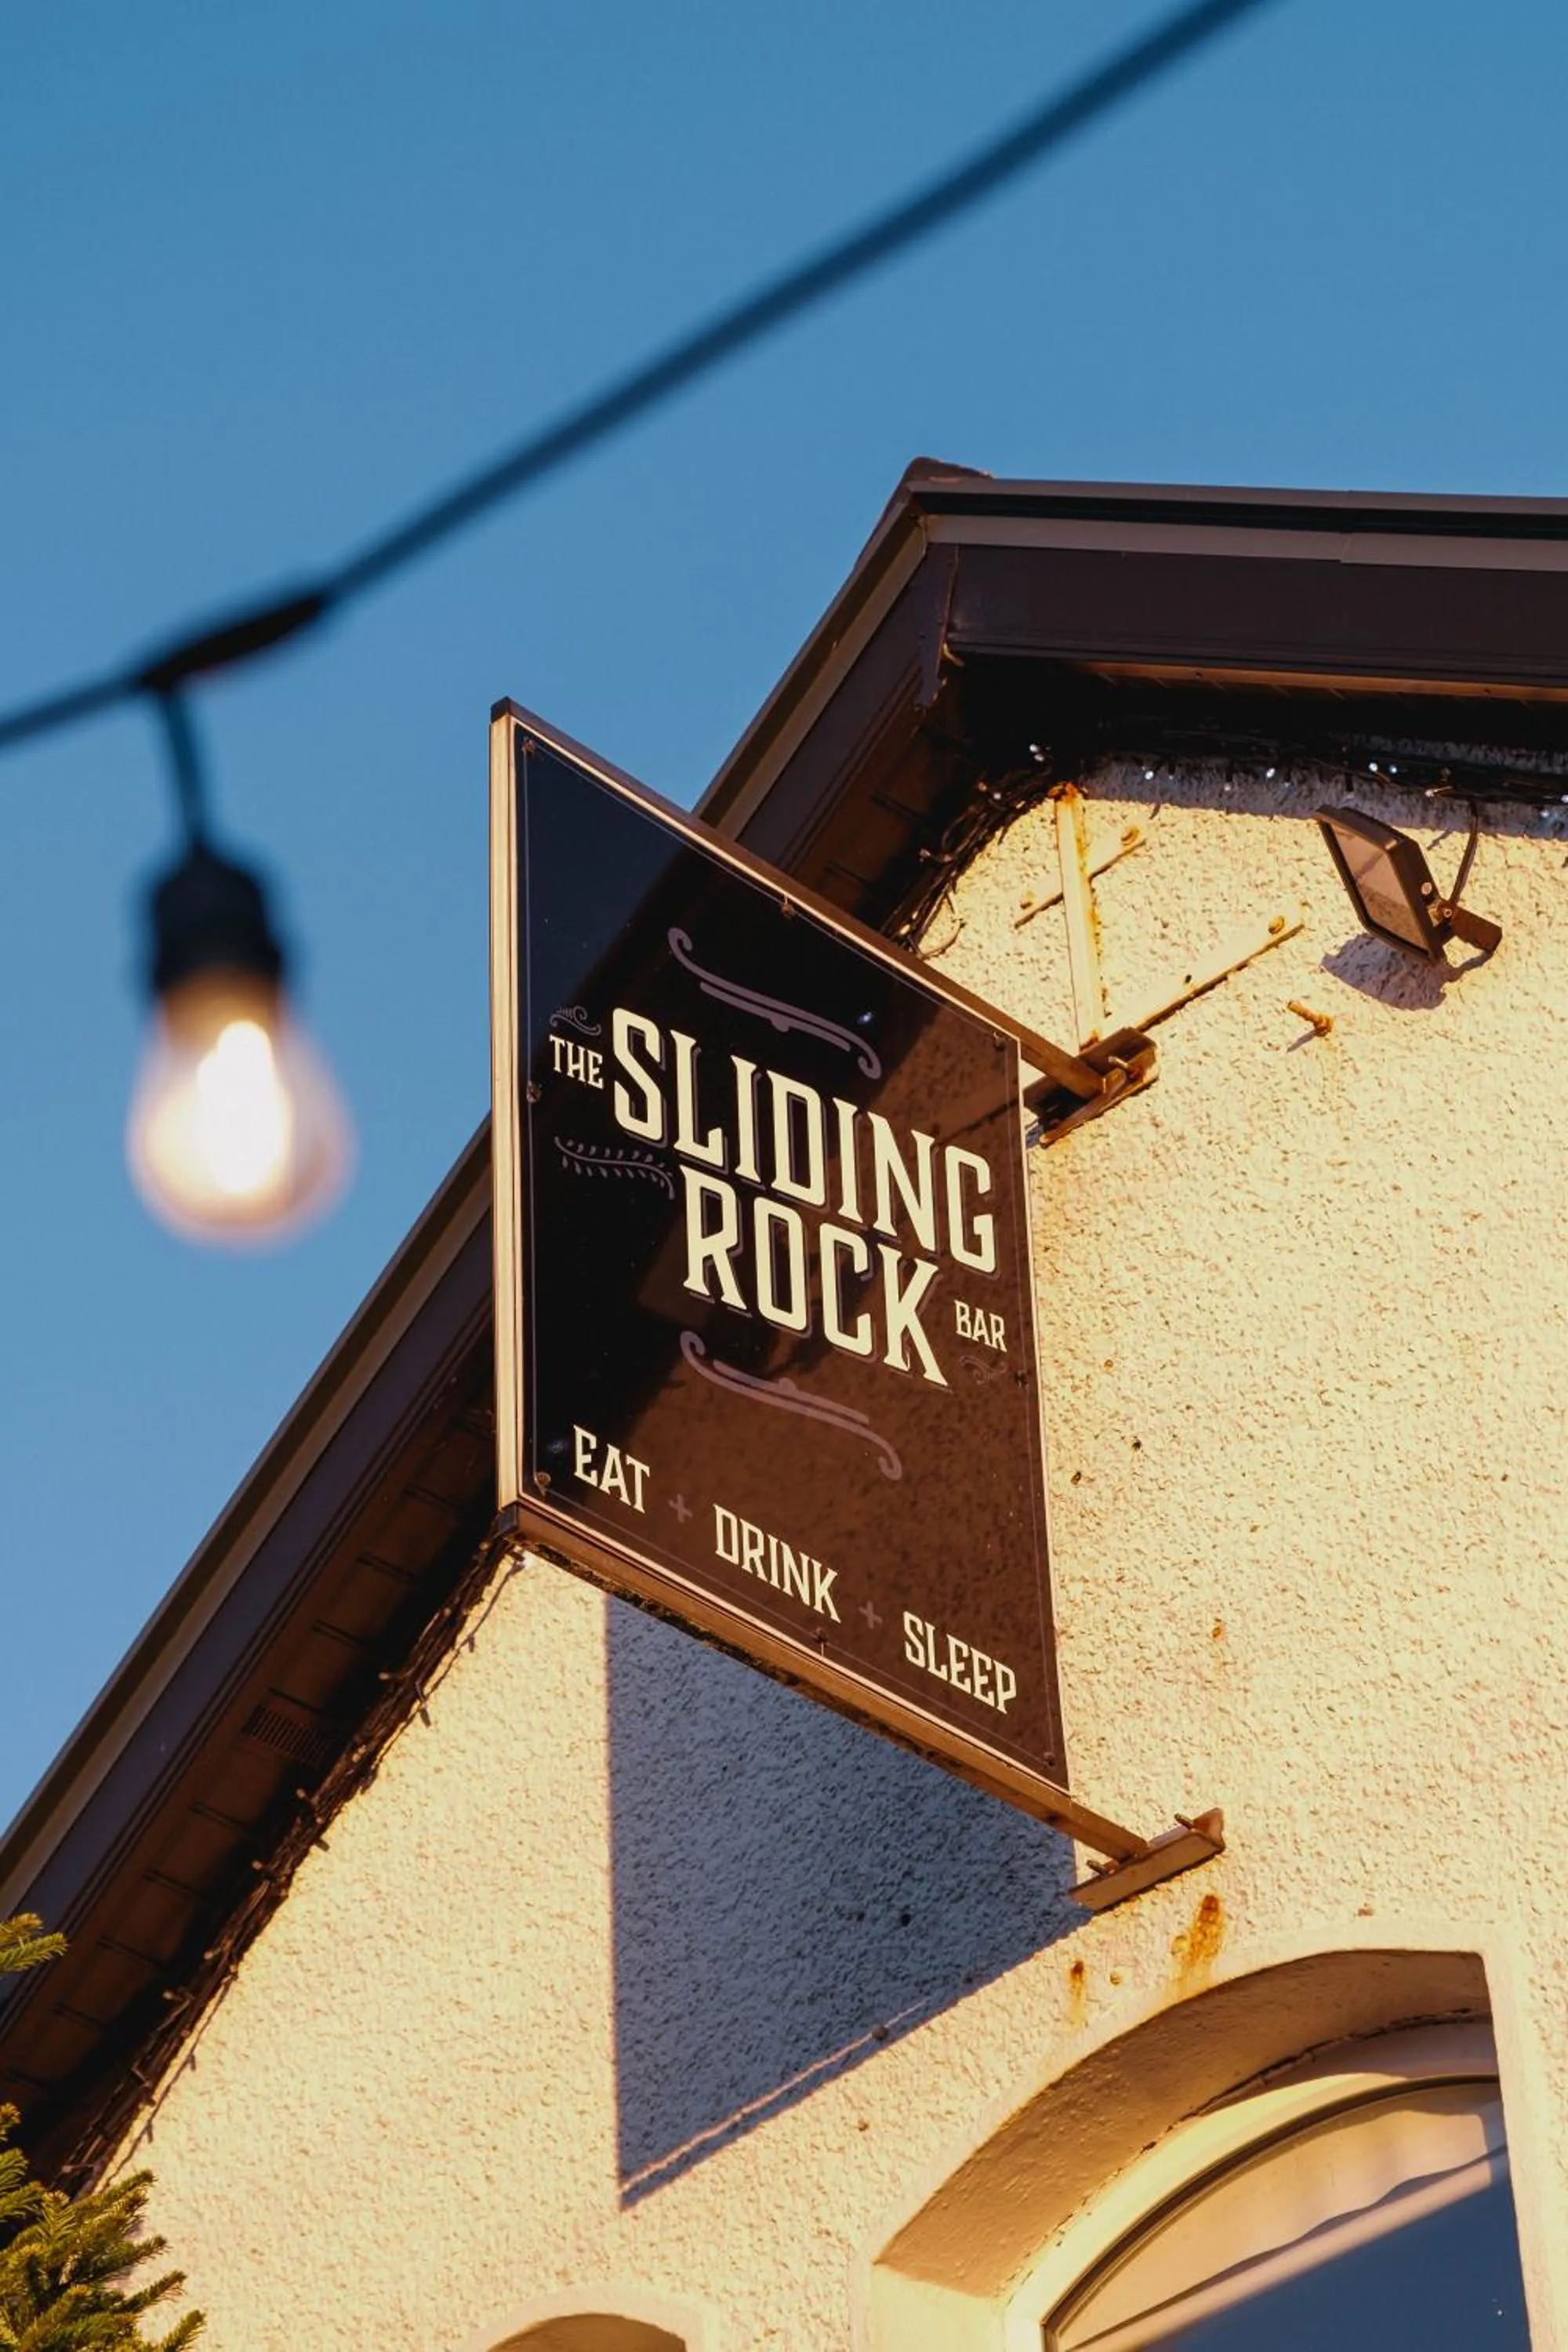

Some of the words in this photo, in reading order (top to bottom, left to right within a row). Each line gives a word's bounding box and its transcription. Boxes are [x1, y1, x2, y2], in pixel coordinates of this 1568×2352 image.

[549, 1033, 604, 1091] THE
[612, 1007, 997, 1274] SLIDING
[678, 1163, 949, 1388] ROCK
[953, 1298, 1008, 1353] BAR
[572, 1424, 651, 1515] EAT
[712, 1503, 842, 1624] DRINK
[902, 1610, 1018, 1715] SLEEP
